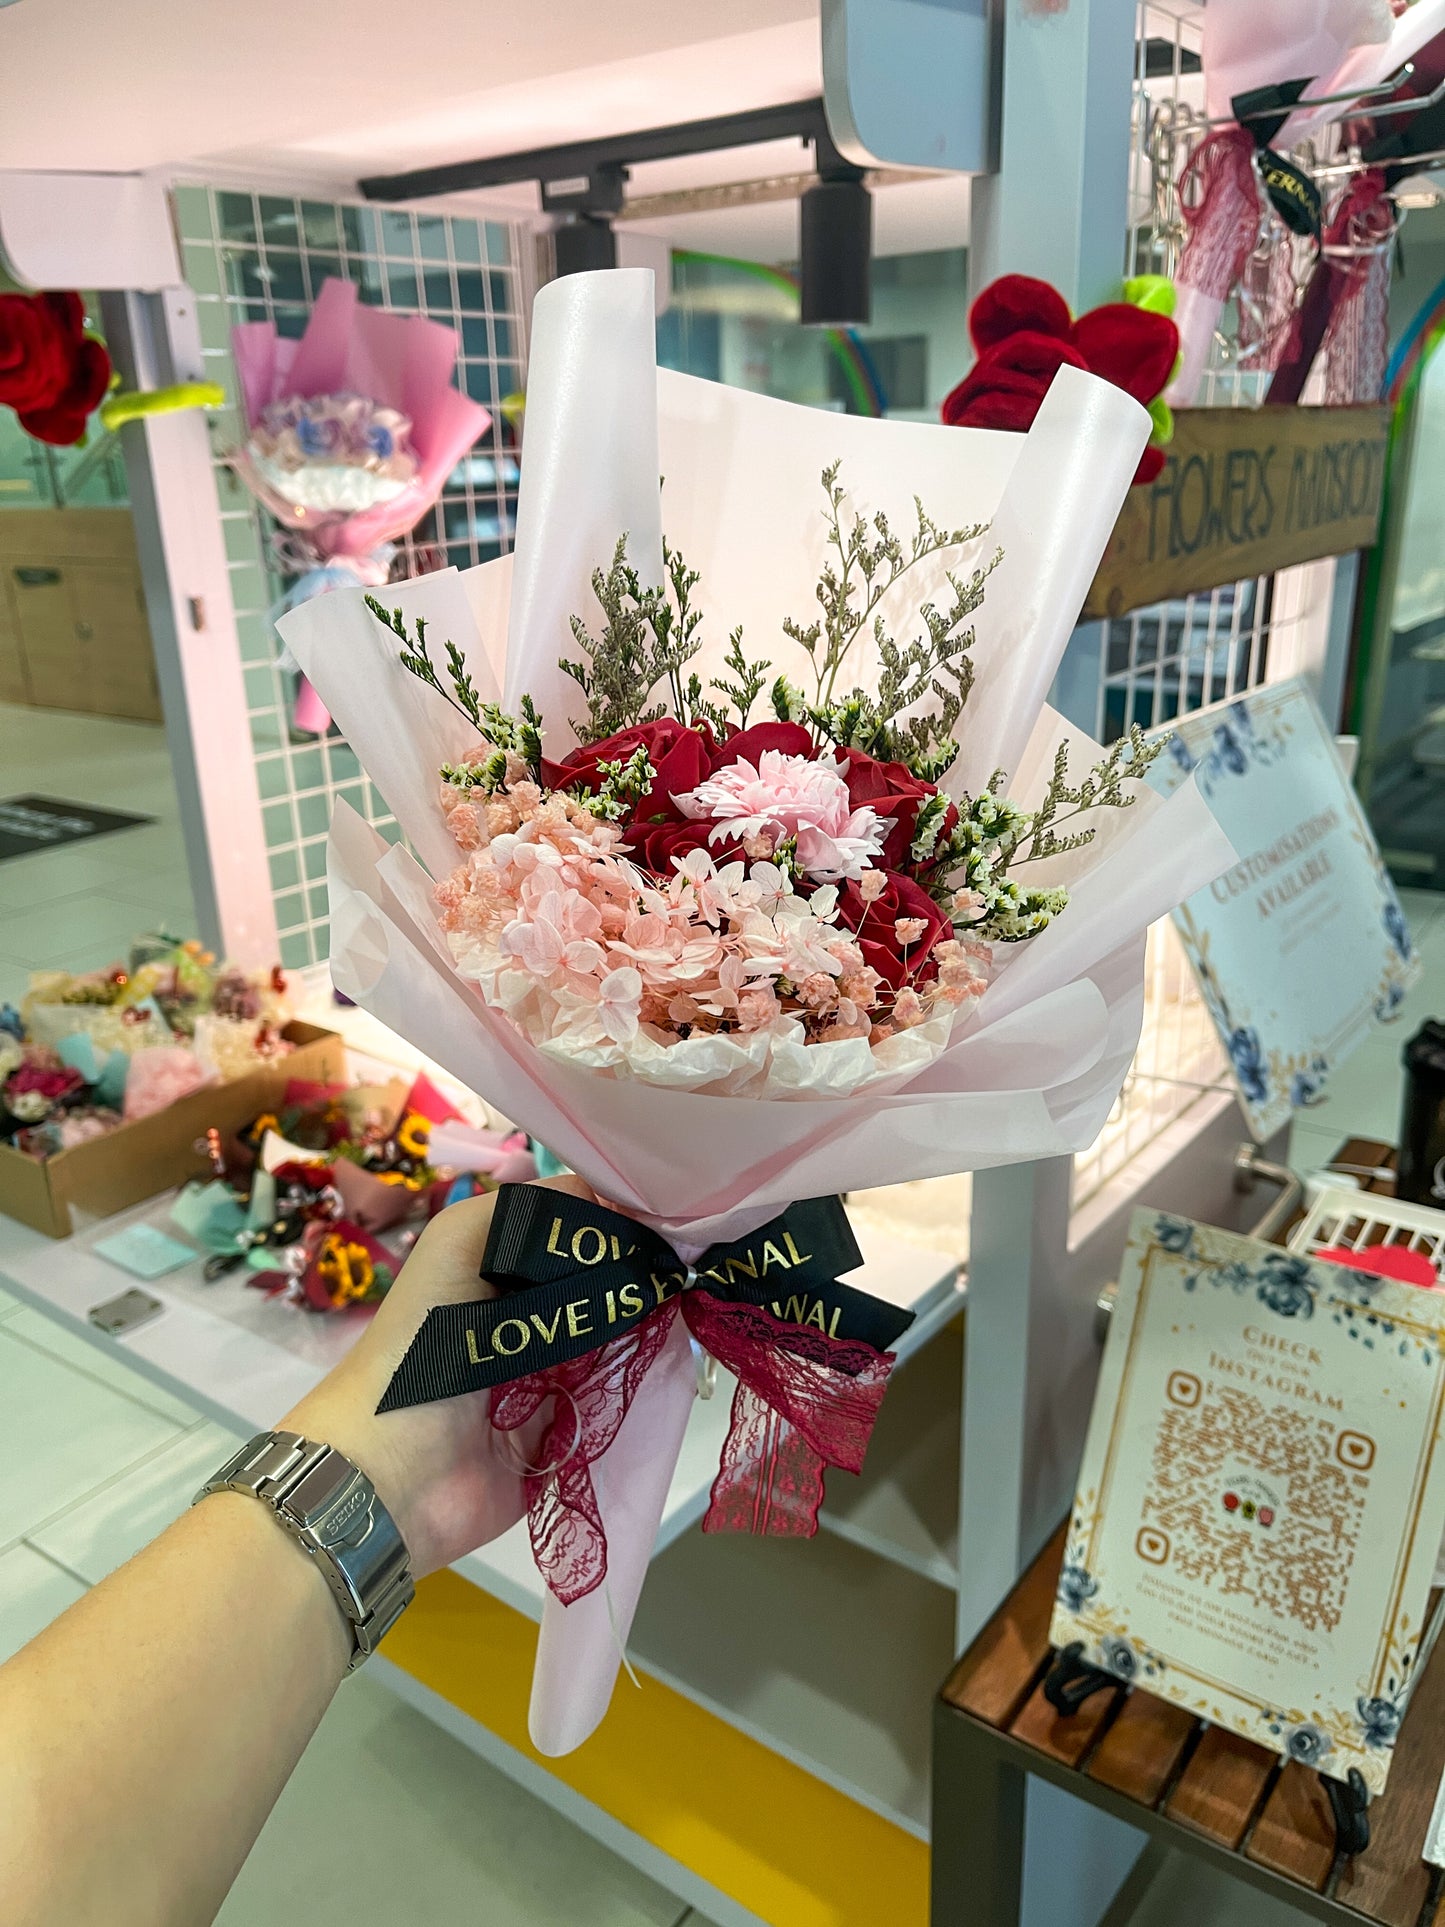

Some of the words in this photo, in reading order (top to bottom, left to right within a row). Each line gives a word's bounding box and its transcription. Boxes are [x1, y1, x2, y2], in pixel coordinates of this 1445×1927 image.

[1256, 849, 1333, 921] AVAILABLE
[465, 1298, 594, 1365] LOVE
[605, 1283, 644, 1324] IS
[1242, 1324, 1323, 1367] CHECK
[1208, 1350, 1345, 1412] INSTAGRAM
[326, 1490, 367, 1536] SEIKO
